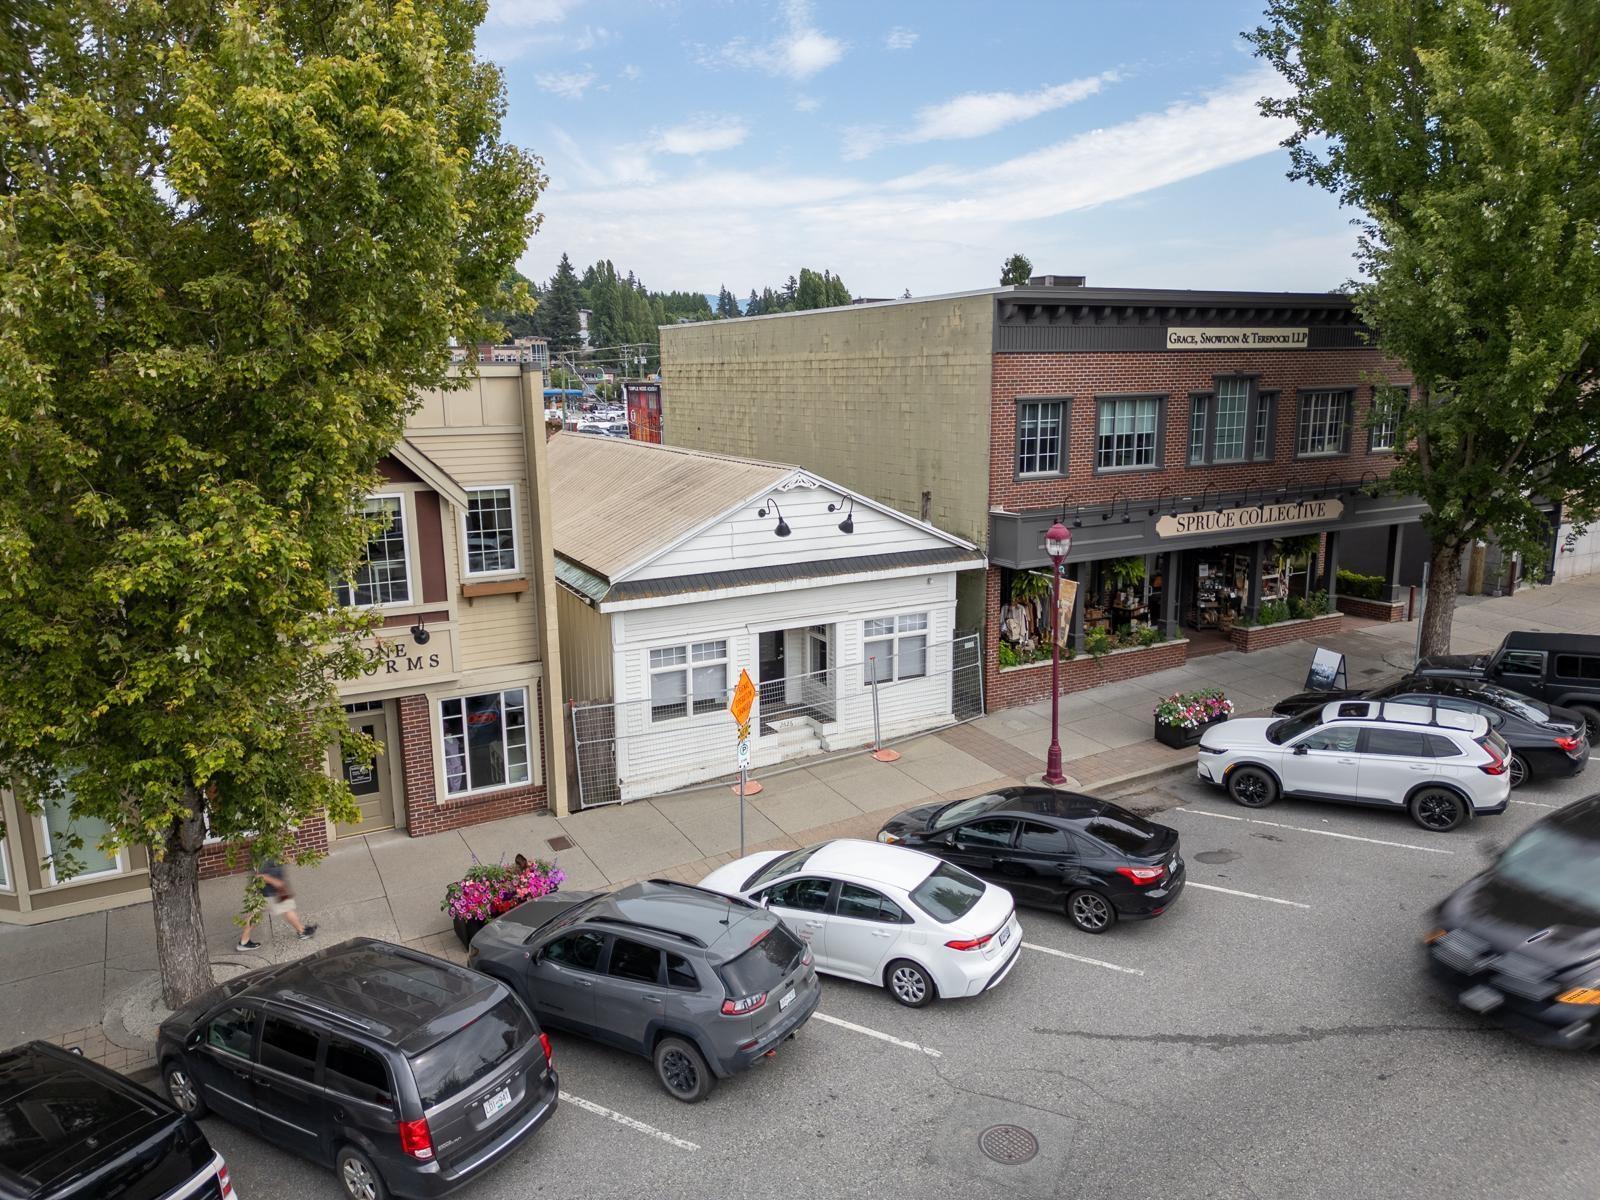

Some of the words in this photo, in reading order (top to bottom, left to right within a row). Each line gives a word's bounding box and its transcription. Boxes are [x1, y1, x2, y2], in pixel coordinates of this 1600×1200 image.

[1169, 332, 1198, 345] GRACE,
[1200, 332, 1240, 344] SNOWDON
[1241, 333, 1250, 344] &
[1292, 332, 1308, 344] LLP
[1176, 512, 1235, 533] SPRUCE
[1239, 502, 1326, 526] COLLECTIVE
